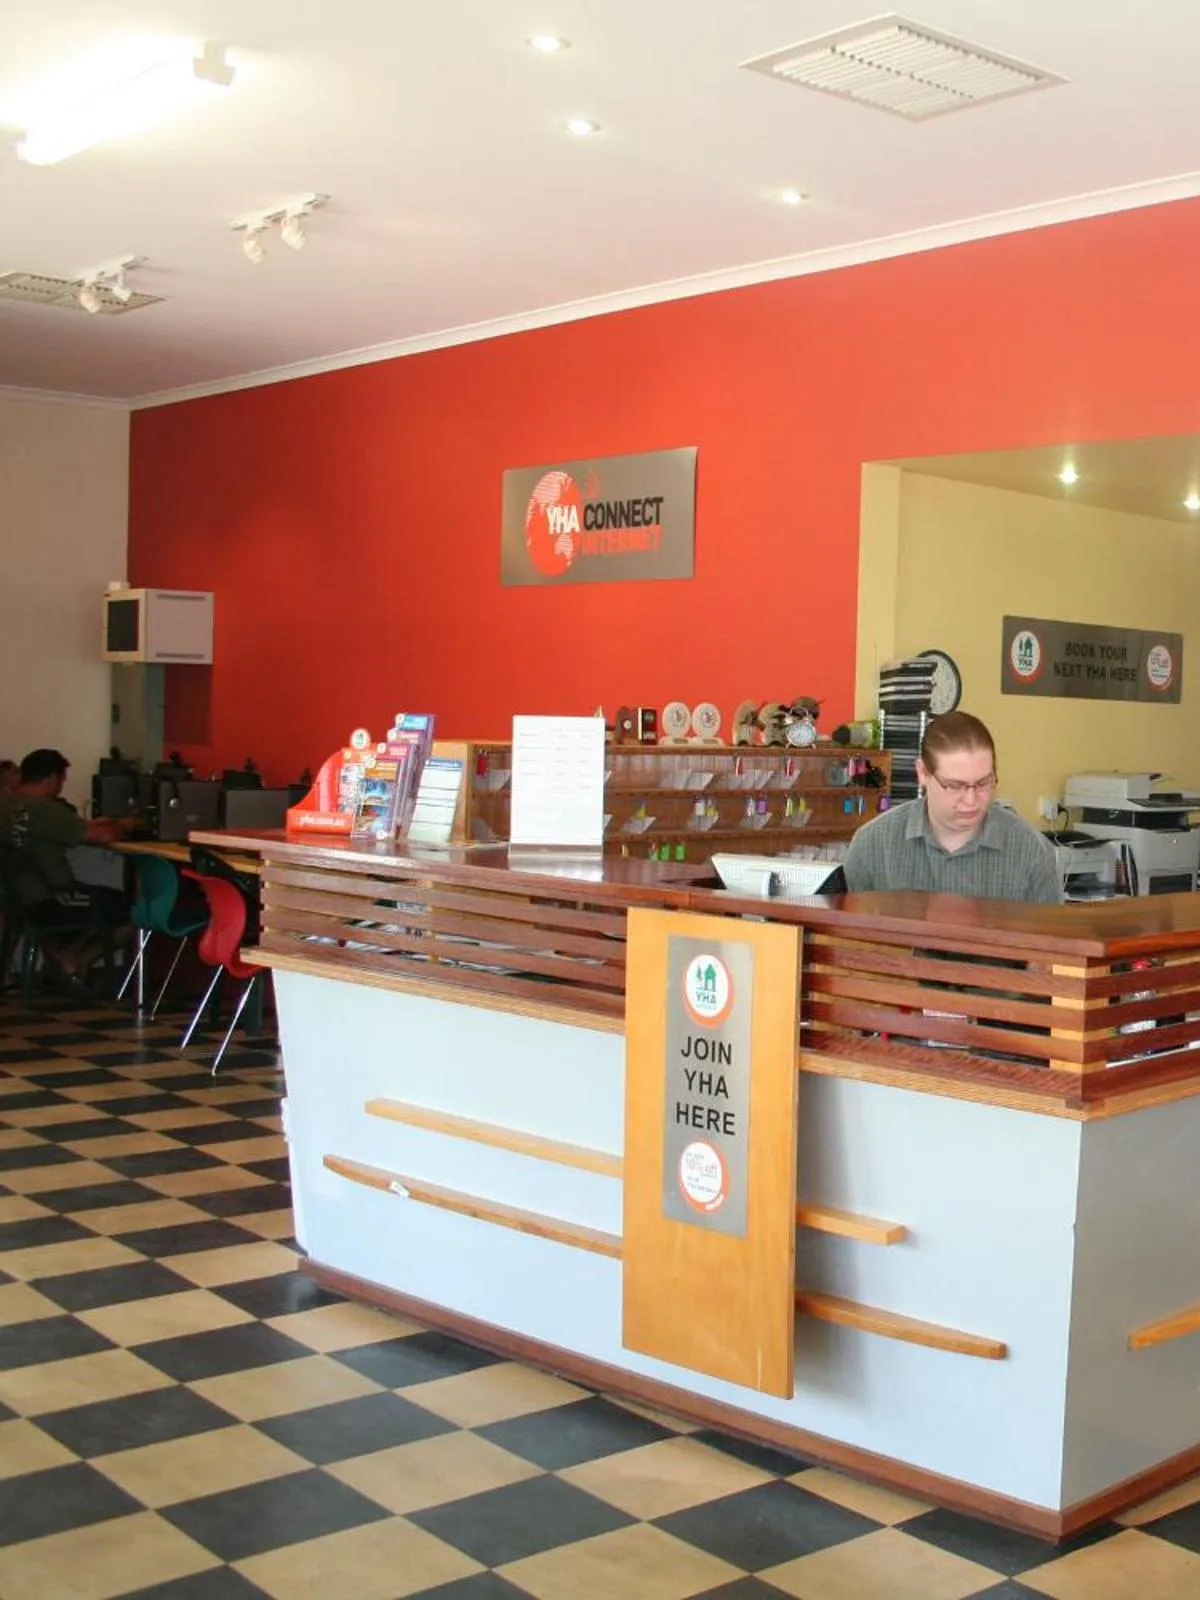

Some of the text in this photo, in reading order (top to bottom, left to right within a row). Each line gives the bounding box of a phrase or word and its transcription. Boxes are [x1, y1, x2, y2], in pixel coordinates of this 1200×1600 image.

[546, 496, 664, 535] YHA CONNECT
[1065, 642, 1128, 661] BOOK YOUR
[1054, 661, 1139, 682] NEXT YHA HERE
[695, 991, 717, 1005] YHA
[681, 1036, 733, 1066] JOIN
[684, 1068, 730, 1099] YHA
[676, 1101, 736, 1136] HERE
